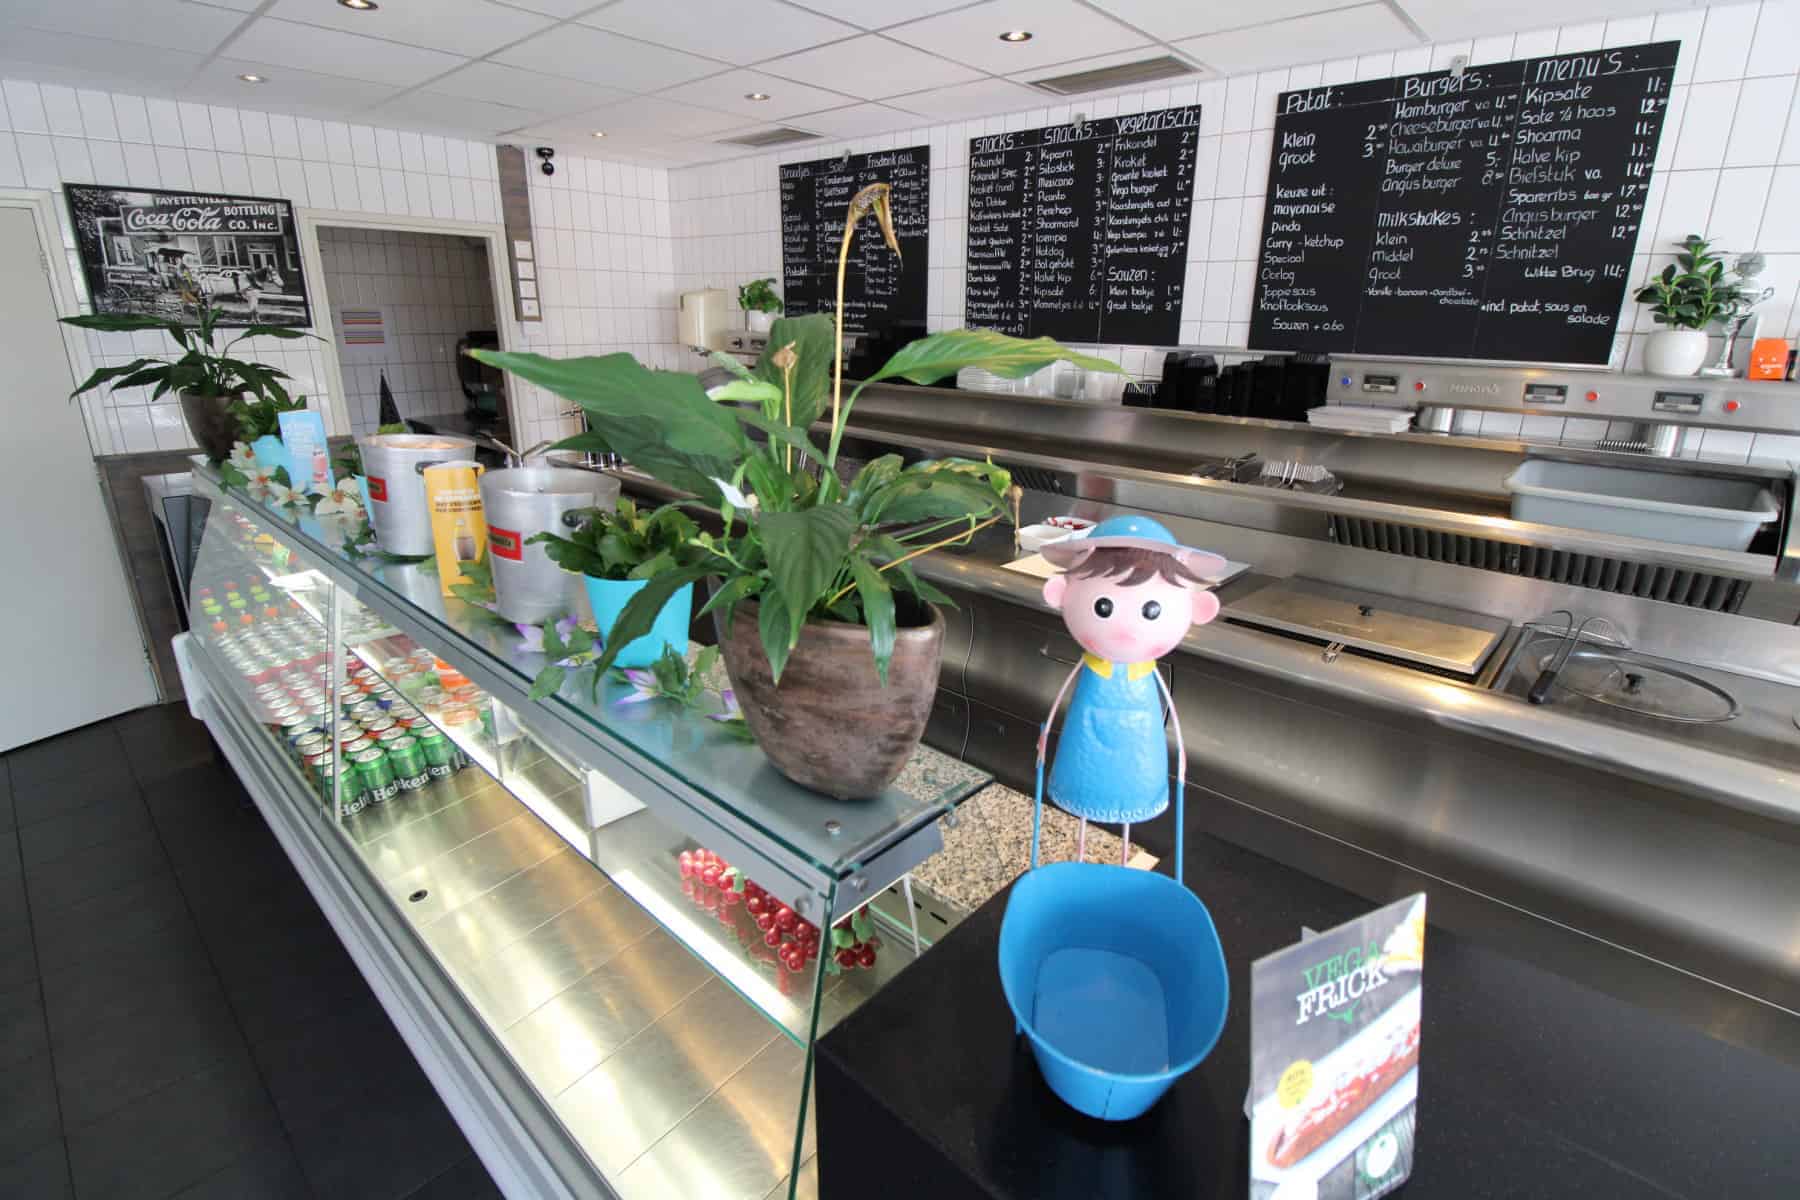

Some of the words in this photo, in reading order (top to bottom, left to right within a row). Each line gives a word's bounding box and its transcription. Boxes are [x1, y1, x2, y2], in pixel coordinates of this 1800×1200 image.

[1395, 99, 1470, 119] Hamburger
[1390, 116, 1478, 138] Cheeseburger
[1515, 128, 1582, 145] Shoarma
[1279, 150, 1316, 173] groot
[1512, 147, 1551, 165] Halve
[1385, 158, 1425, 180] Burger
[1422, 174, 1463, 195] burger
[1507, 188, 1577, 205] Spareribs
[126, 206, 222, 232] Coca-Cola
[223, 205, 276, 217] BOTTLING
[1500, 224, 1567, 241] Schnitzel
[1495, 243, 1559, 260] Schnitzel
[1561, 264, 1596, 282] Brug
[1296, 960, 1389, 1026] FRICK
